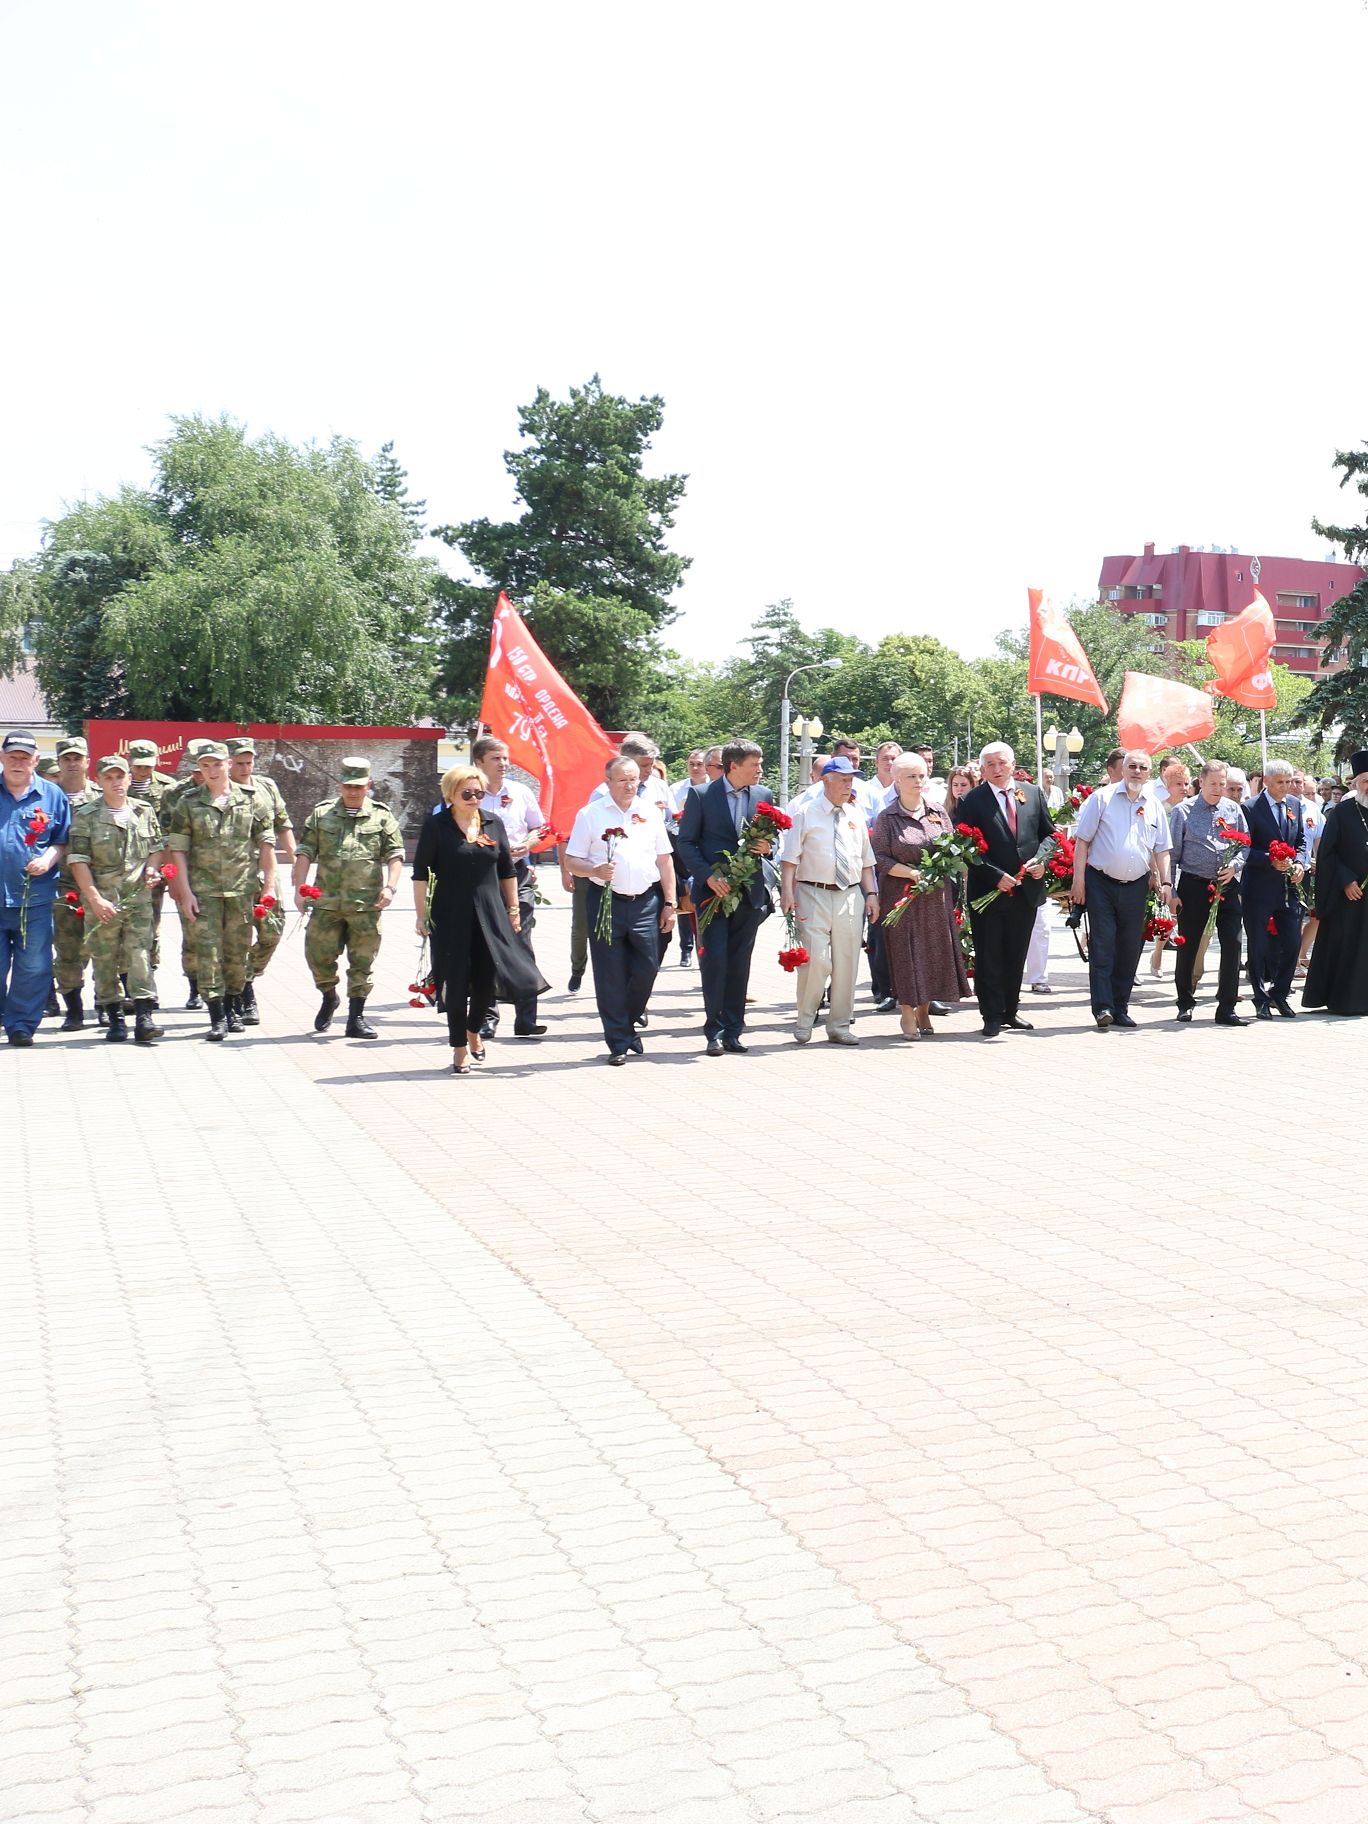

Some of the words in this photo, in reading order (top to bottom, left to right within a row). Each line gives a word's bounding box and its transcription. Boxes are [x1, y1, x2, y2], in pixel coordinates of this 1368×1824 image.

[506, 646, 529, 666] 150
[534, 689, 569, 729] ОРДЕНА
[1045, 658, 1091, 684] КПР
